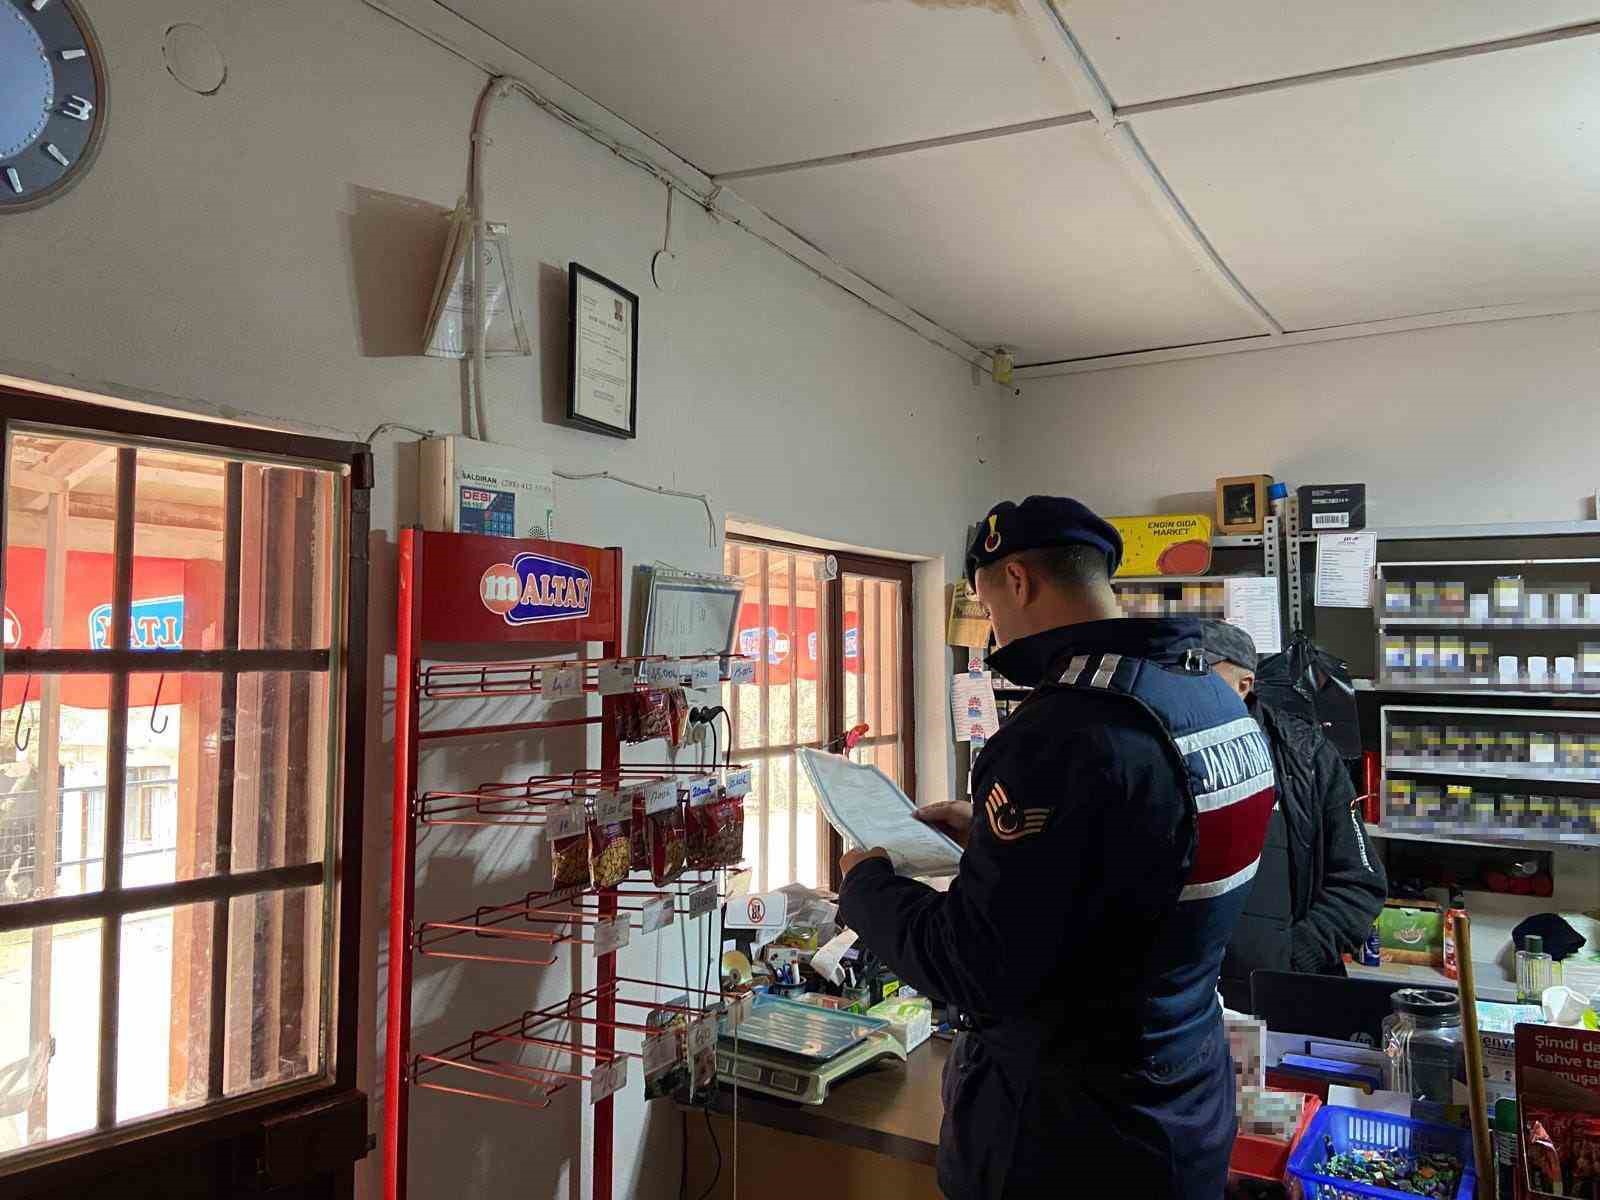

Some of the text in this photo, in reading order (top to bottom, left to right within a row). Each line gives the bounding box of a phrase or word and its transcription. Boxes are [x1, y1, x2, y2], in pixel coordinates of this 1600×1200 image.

[63, 95, 92, 120] 3
[1153, 527, 1189, 537] MARKET
[520, 572, 590, 609] ALTAY
[1535, 1035, 1578, 1050] Şimdi
[1535, 1050, 1582, 1067] kahve
